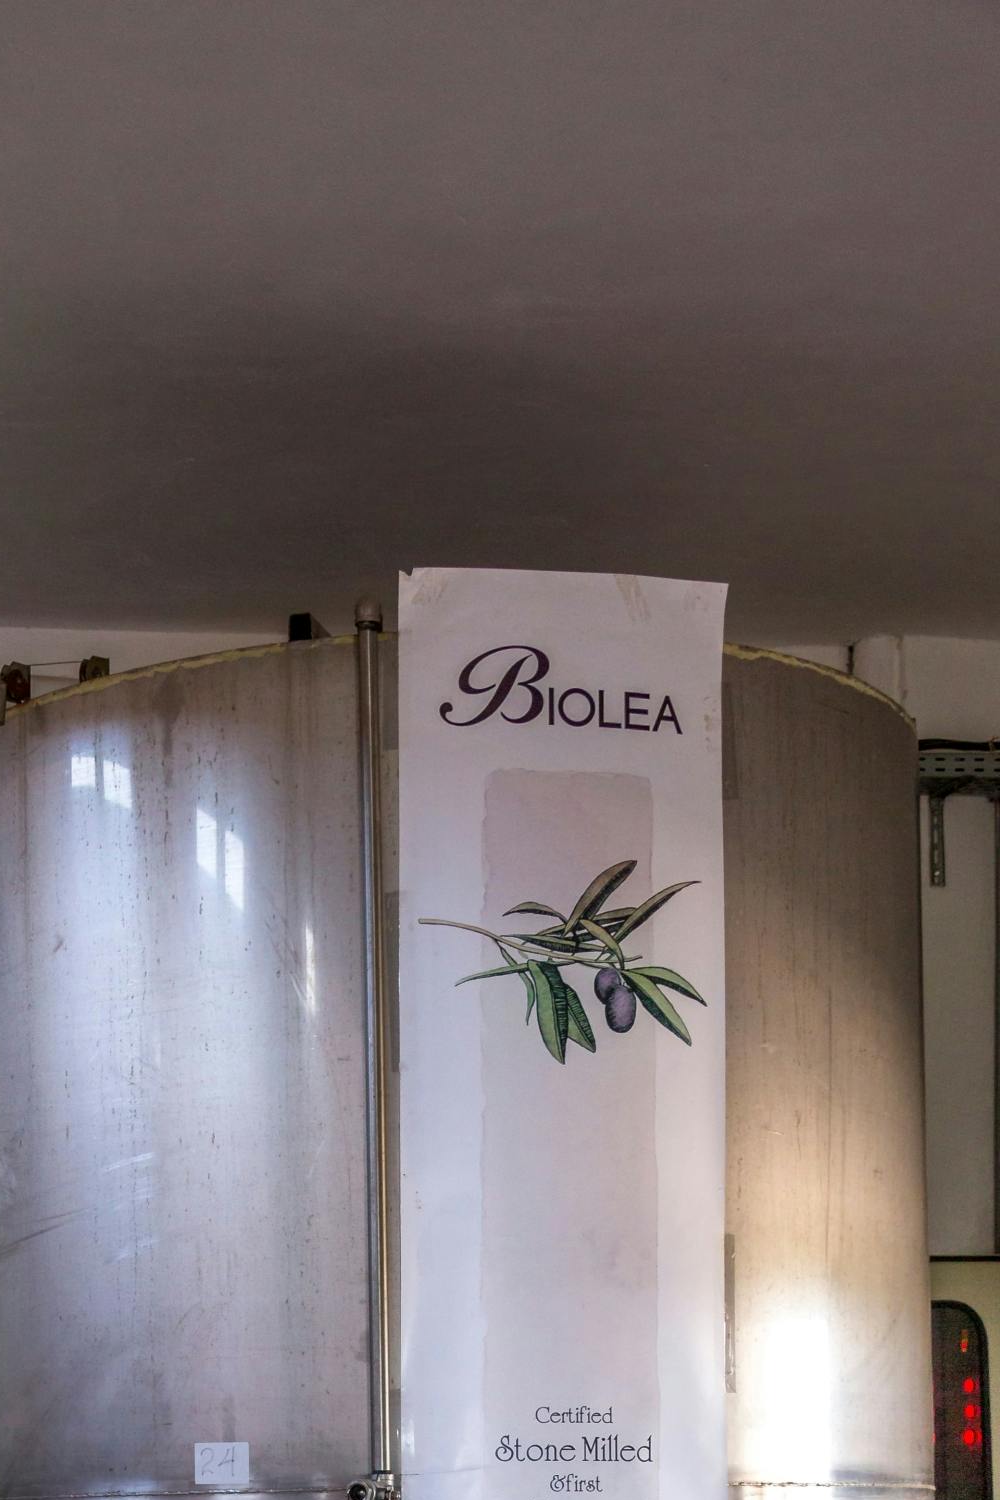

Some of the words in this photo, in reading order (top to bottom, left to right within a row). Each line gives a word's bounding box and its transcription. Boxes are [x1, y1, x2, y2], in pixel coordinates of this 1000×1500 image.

[439, 645, 683, 735] BIOLEA
[535, 1405, 614, 1424] Certified
[200, 1446, 236, 1478] 24
[495, 1434, 576, 1462] Stone
[581, 1434, 654, 1463] Milled
